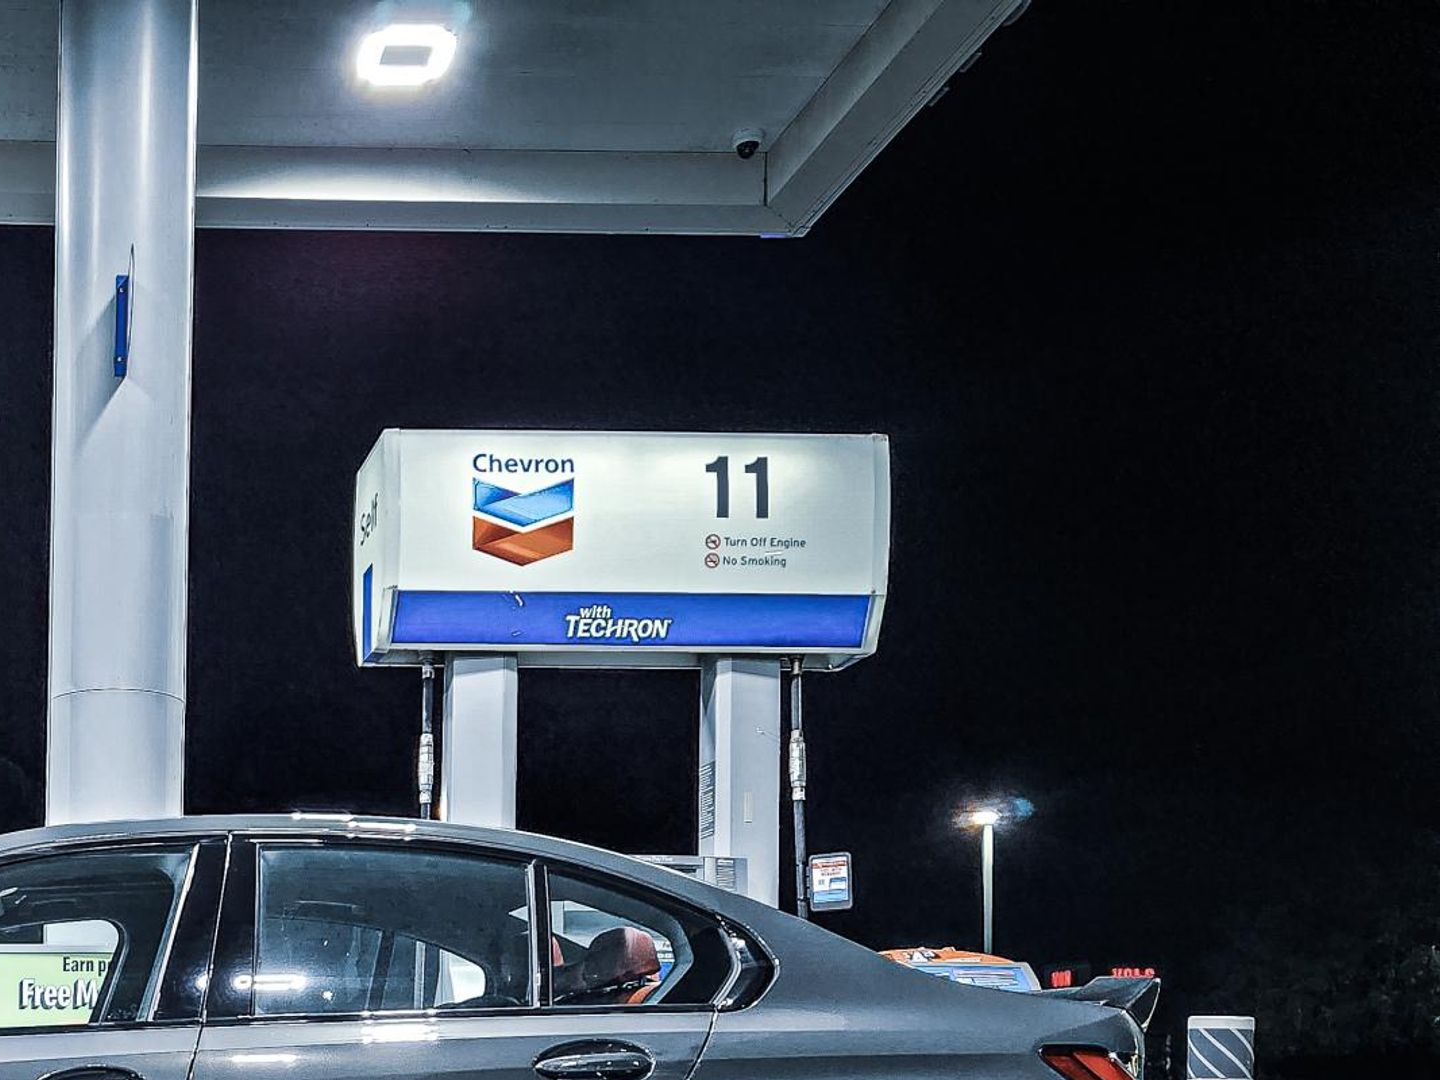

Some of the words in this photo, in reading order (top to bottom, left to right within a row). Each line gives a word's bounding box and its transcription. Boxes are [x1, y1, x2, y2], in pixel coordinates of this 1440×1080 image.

[472, 452, 575, 474] Chevron
[705, 455, 769, 519] 11
[360, 493, 379, 547] Self
[724, 536, 748, 548] Turn
[750, 537, 768, 548] Off
[770, 536, 807, 549] Engine
[722, 556, 738, 566] No
[741, 555, 787, 568] Smoking
[579, 604, 612, 619] with
[565, 614, 671, 642] TECHRON
[62, 956, 95, 973] Earn
[18, 977, 72, 1010] Free
[72, 978, 101, 1010] M
